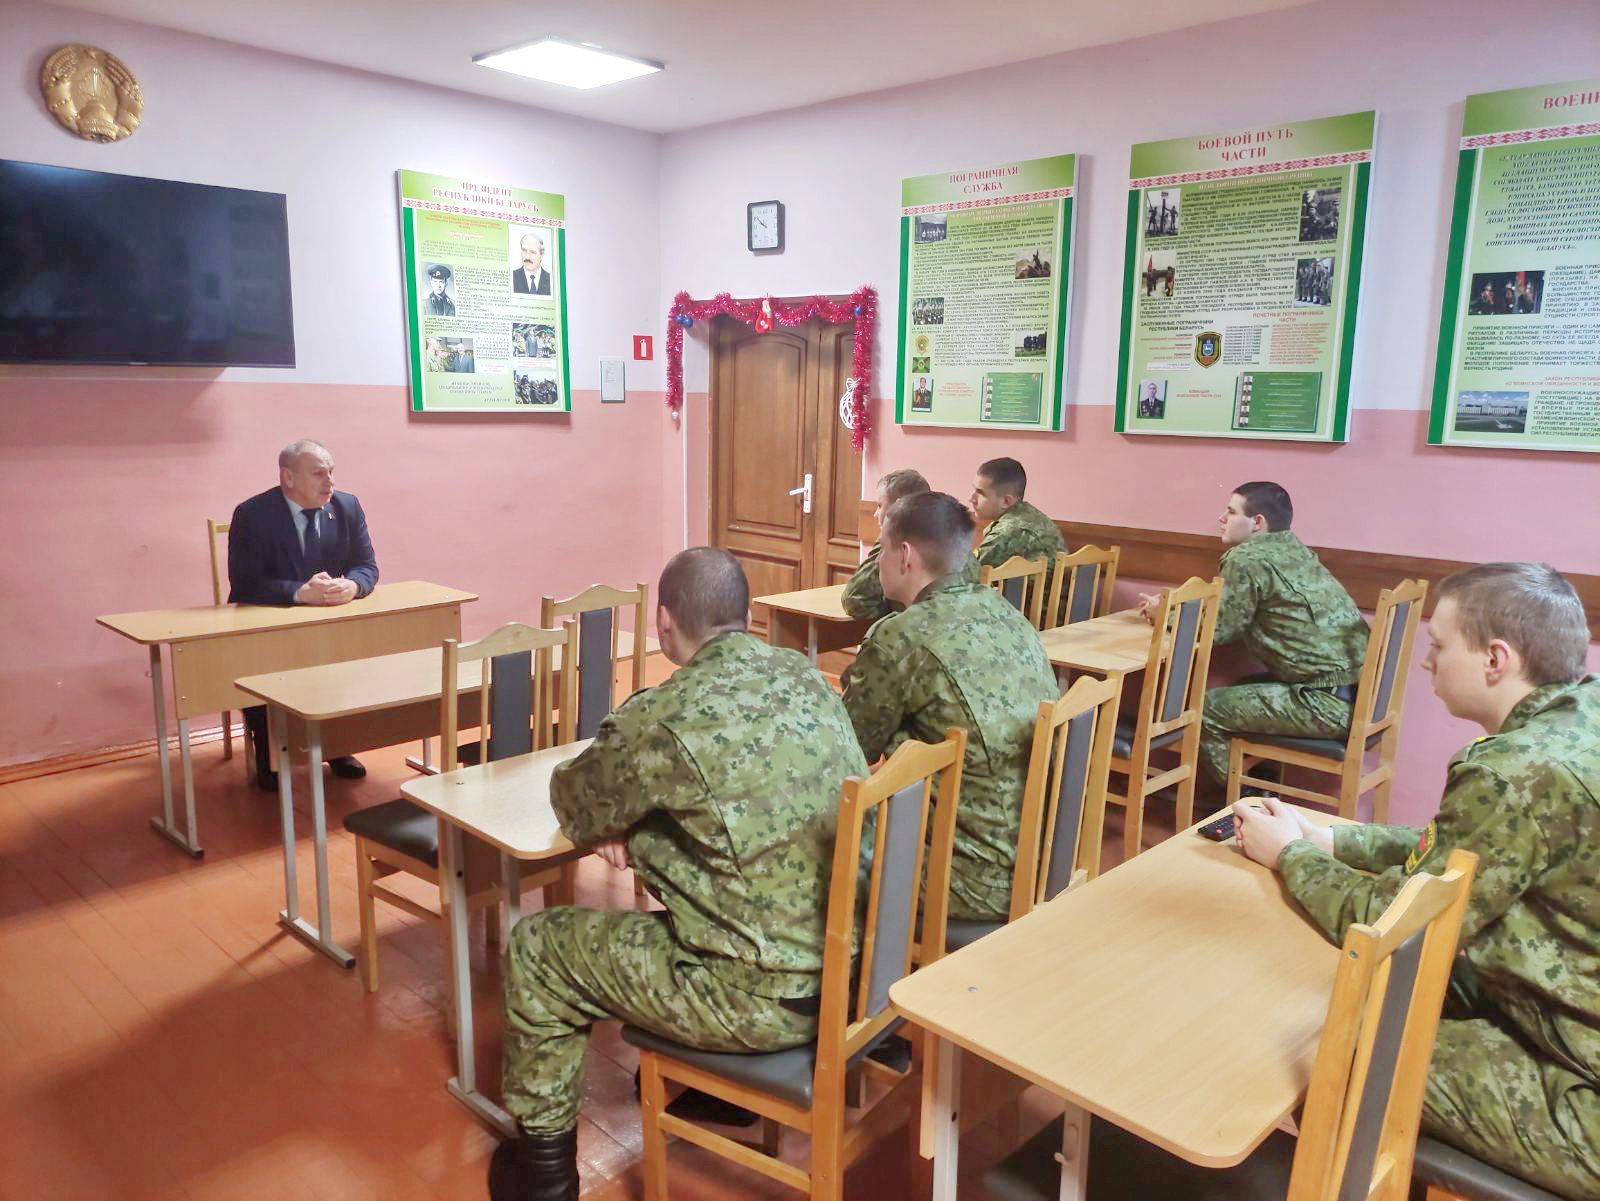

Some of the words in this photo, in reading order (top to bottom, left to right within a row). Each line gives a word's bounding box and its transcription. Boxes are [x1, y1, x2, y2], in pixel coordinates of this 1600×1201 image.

[1198, 132, 1252, 150] БОЕВОЙ
[1256, 128, 1293, 142] ПУТЬ
[1222, 147, 1266, 160] ЧАСТИ
[949, 166, 1020, 184] ПОГРАНИЧНАЯ
[462, 182, 512, 197] ПРЕЗИДЕНТ
[963, 182, 1003, 194] СЛУЖБА
[433, 188, 494, 204] РЕСПУБЛИКИ
[496, 198, 540, 212] БЕЛАРУСЬ
